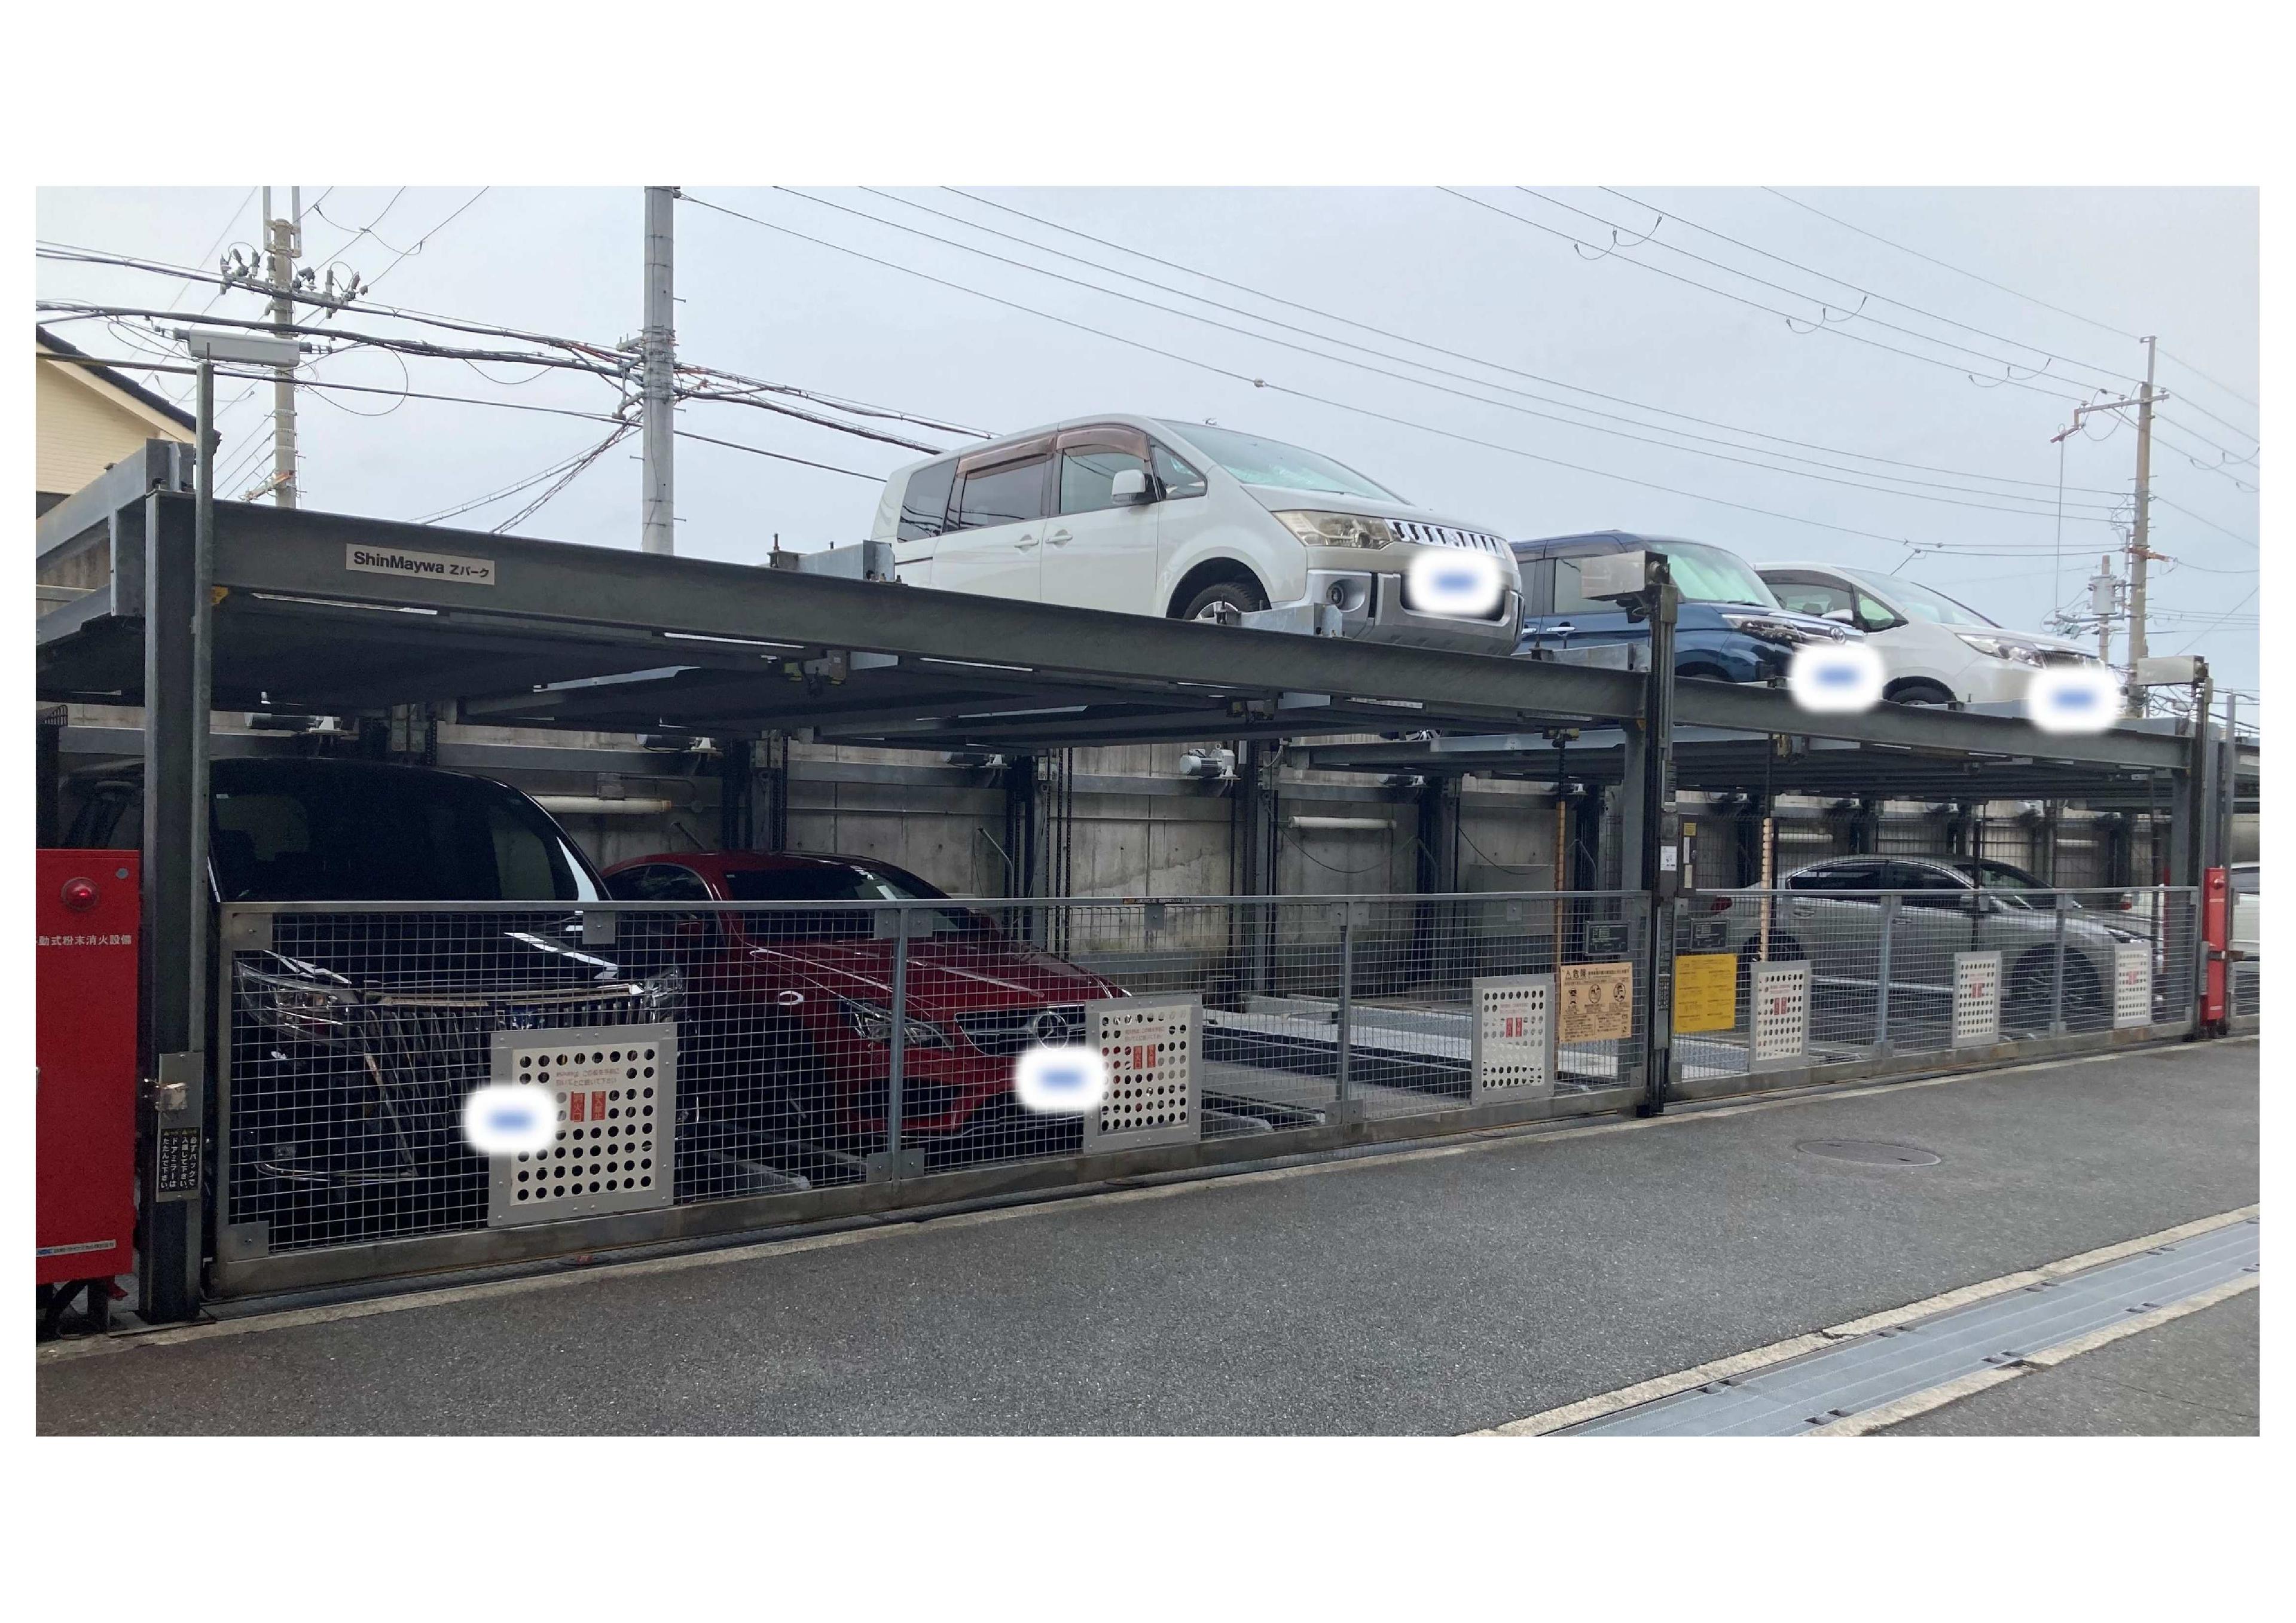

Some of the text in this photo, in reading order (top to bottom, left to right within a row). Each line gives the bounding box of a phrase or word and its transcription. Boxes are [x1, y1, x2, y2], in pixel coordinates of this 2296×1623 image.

[353, 551, 489, 578] ShinMaywa Zパーク
[36, 934, 132, 946] 動式粉末消火設備
[169, 1137, 178, 1187] ドアミラーは
